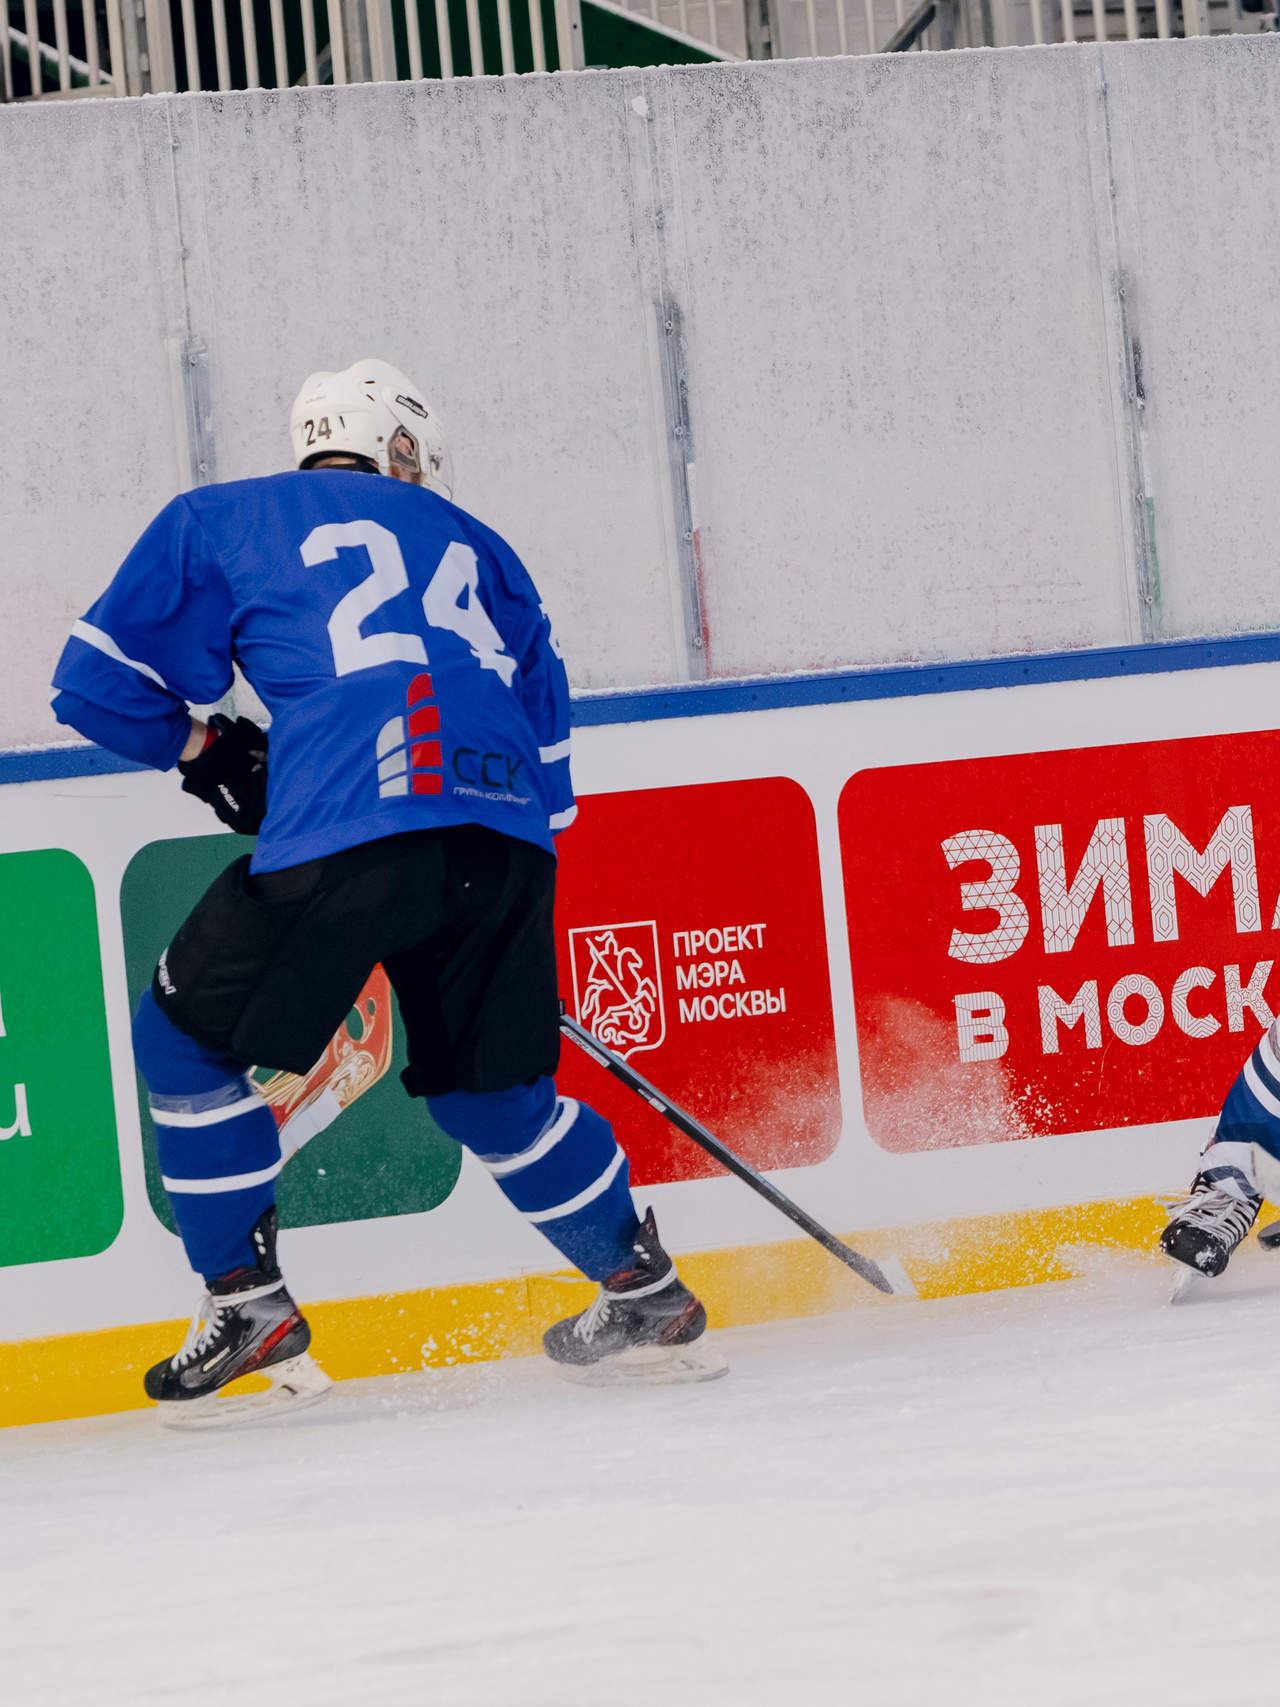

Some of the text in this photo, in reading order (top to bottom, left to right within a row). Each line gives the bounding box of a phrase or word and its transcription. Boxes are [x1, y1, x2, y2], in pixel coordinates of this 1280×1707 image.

[304, 416, 332, 447] 24
[299, 518, 518, 689] 24
[672, 923, 767, 958] ПРОЕКТ
[675, 959, 746, 991] МЭРА
[678, 987, 787, 1024] МОСКВЫ
[954, 991, 1010, 1064] В
